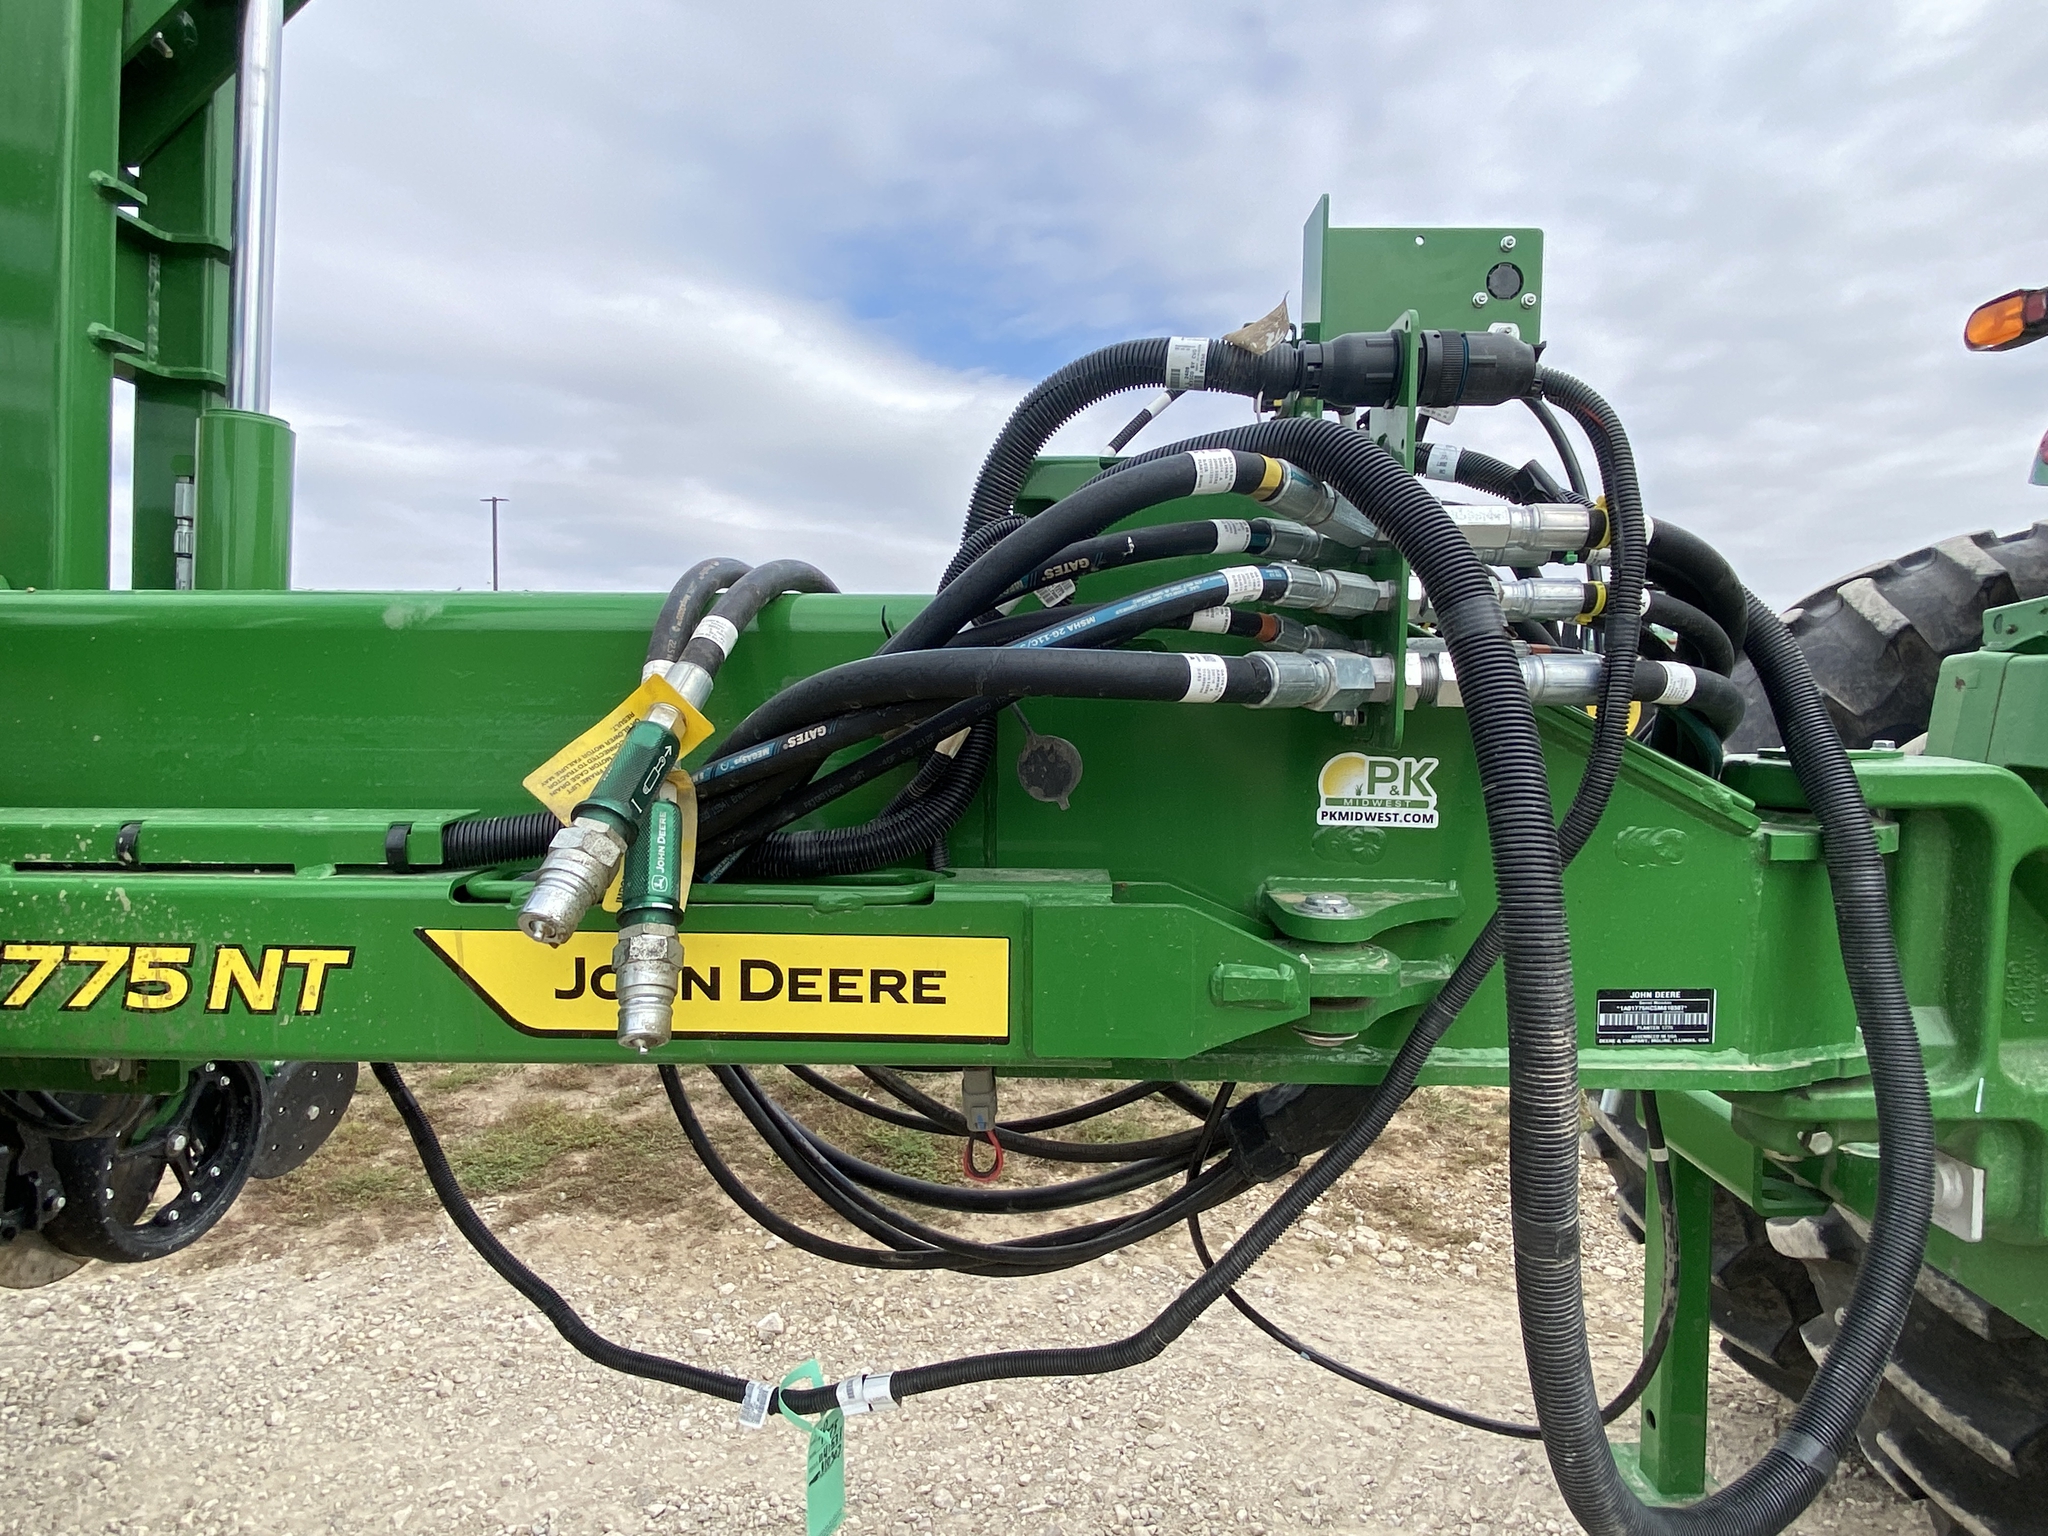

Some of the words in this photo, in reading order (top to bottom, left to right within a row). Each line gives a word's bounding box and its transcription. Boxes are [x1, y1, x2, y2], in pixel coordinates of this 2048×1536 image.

[1066, 615, 1096, 633] MSHA
[605, 726, 631, 745] BLOWER
[582, 744, 605, 758] MOTOR
[554, 757, 583, 777] FAILURE
[578, 762, 587, 770] TO
[589, 756, 612, 771] MOTOR
[541, 776, 554, 787] MAY
[548, 767, 578, 790] TRACTOR
[570, 769, 589, 783] CASE
[581, 769, 603, 784] FRAME
[1368, 760, 1434, 797] P&K
[550, 780, 571, 797] DRAIN
[567, 782, 581, 794] LIFT
[1343, 799, 1411, 808] MIDWEST
[1321, 811, 1434, 823] PKMIDWEST.COM
[656, 811, 667, 844] DEERE
[654, 845, 667, 873] JOHN
[205, 944, 355, 1015] NT
[554, 958, 720, 1001] JON
[740, 958, 947, 1004] DEERE
